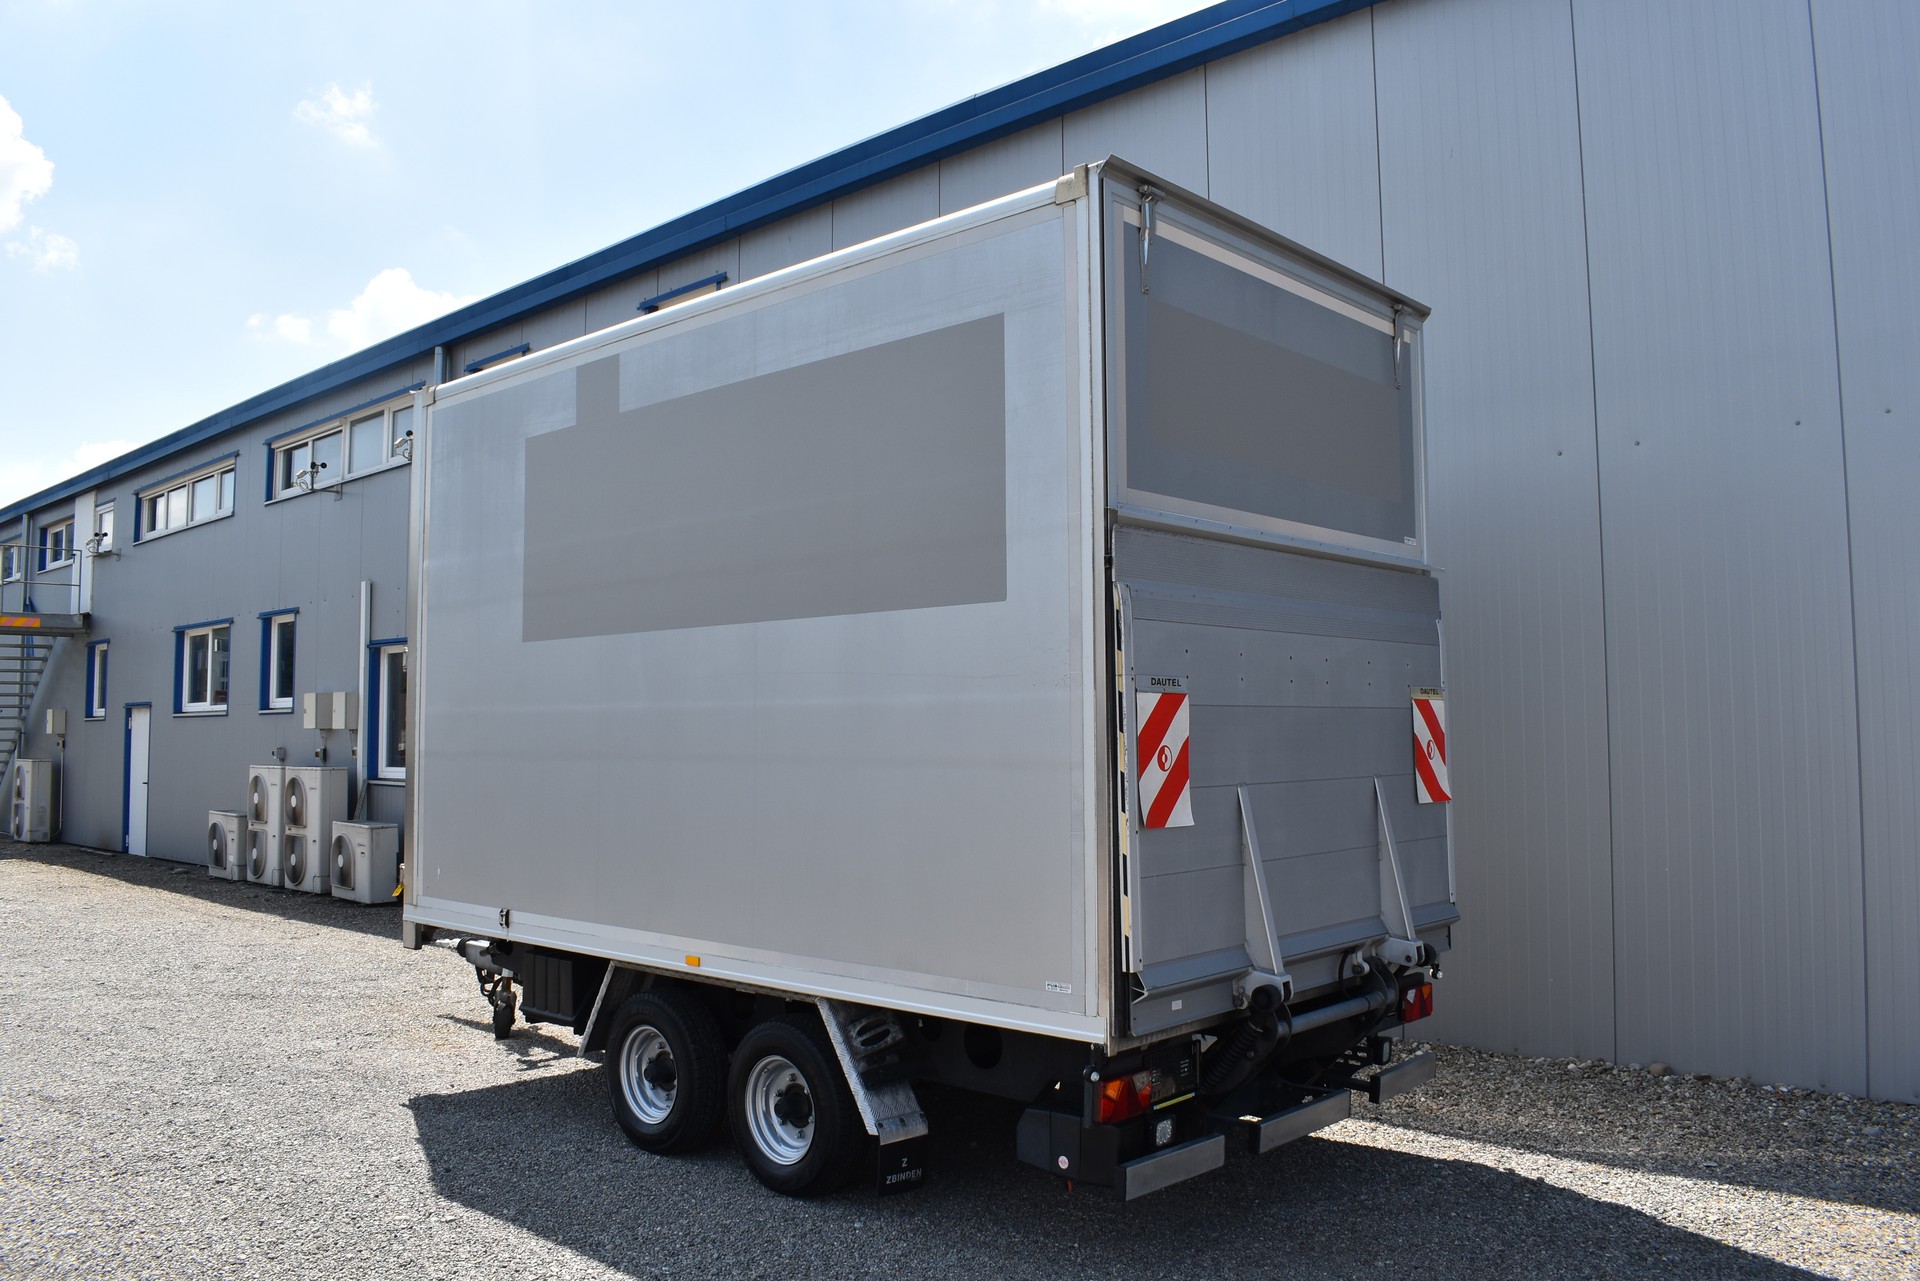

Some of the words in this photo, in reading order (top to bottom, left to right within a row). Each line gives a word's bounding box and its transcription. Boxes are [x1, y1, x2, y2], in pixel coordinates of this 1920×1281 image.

[1150, 677, 1182, 687] DAUTEL
[1420, 688, 1439, 696] DAUTEL
[901, 1157, 908, 1168] Z
[886, 1168, 922, 1184] ZBINDEN
